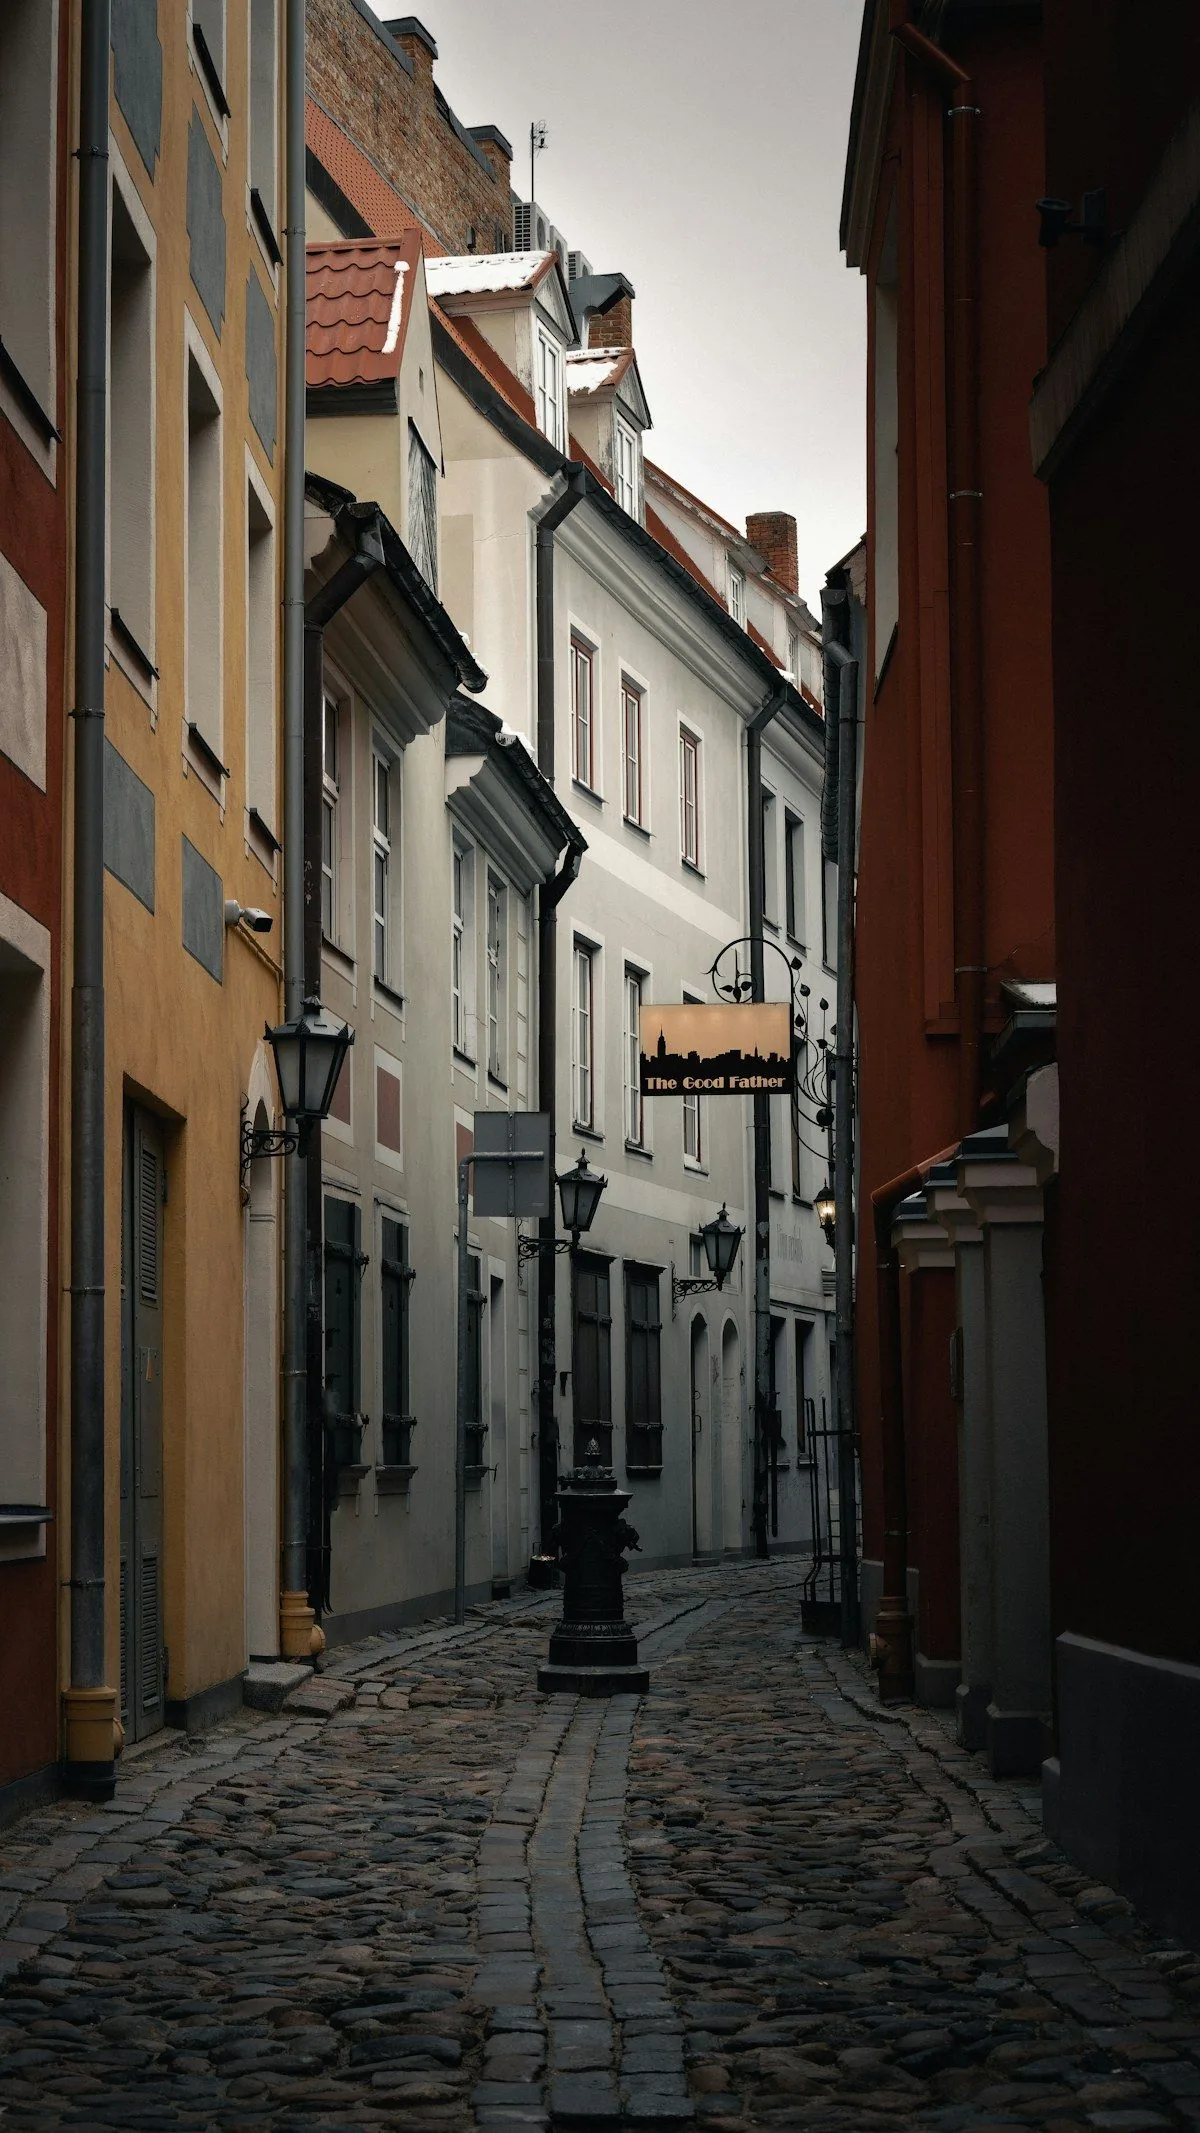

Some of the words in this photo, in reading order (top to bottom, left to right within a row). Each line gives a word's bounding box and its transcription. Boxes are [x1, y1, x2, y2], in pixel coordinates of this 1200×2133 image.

[645, 1077, 677, 1089] The
[682, 1076, 725, 1089] Good
[729, 1075, 786, 1089] Father
